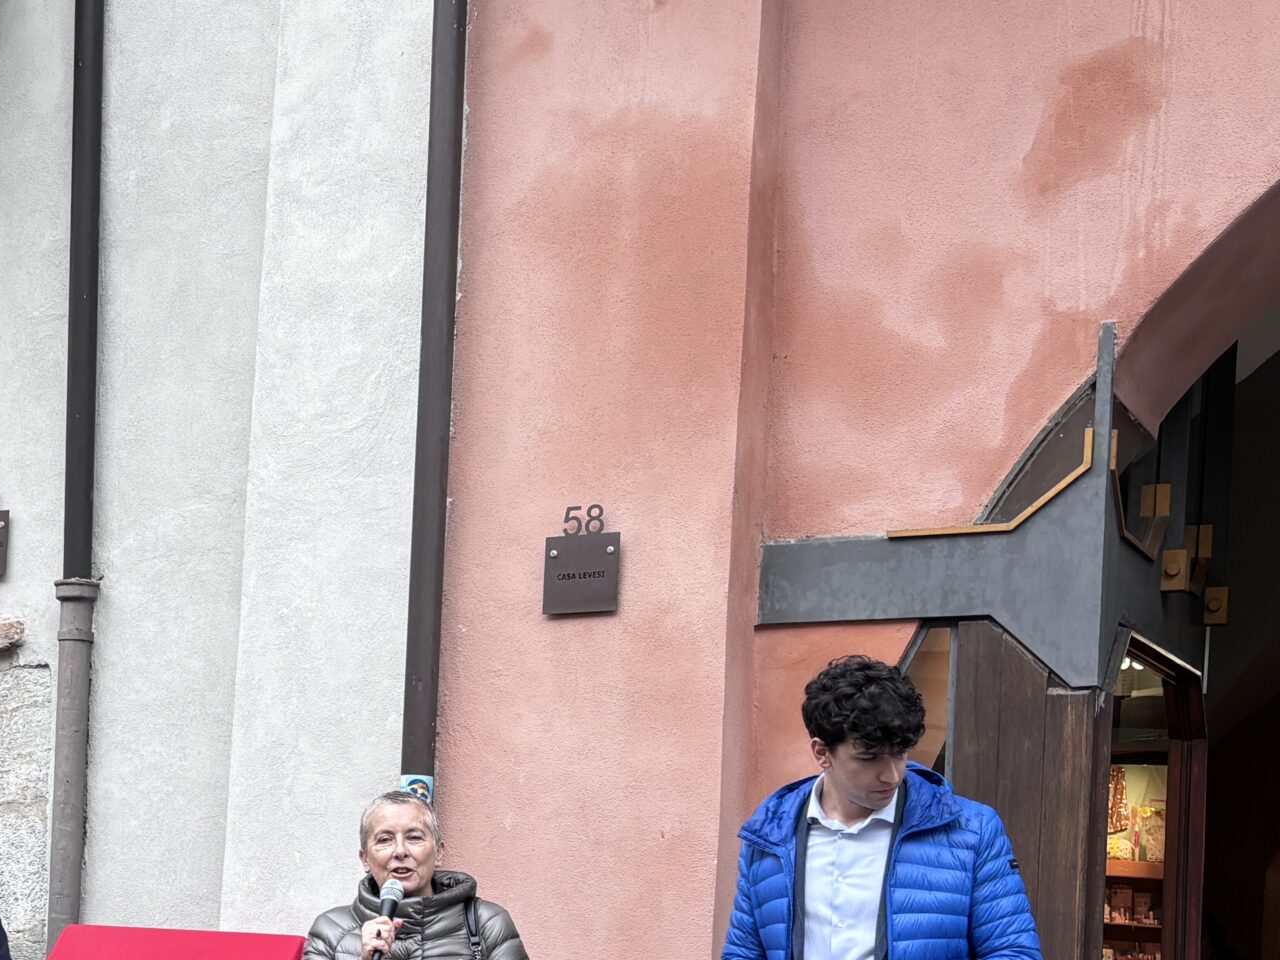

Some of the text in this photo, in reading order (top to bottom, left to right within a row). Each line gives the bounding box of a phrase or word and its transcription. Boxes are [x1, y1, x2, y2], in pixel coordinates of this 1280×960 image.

[563, 504, 605, 536] 58
[557, 570, 605, 581] CASA LEVESI
